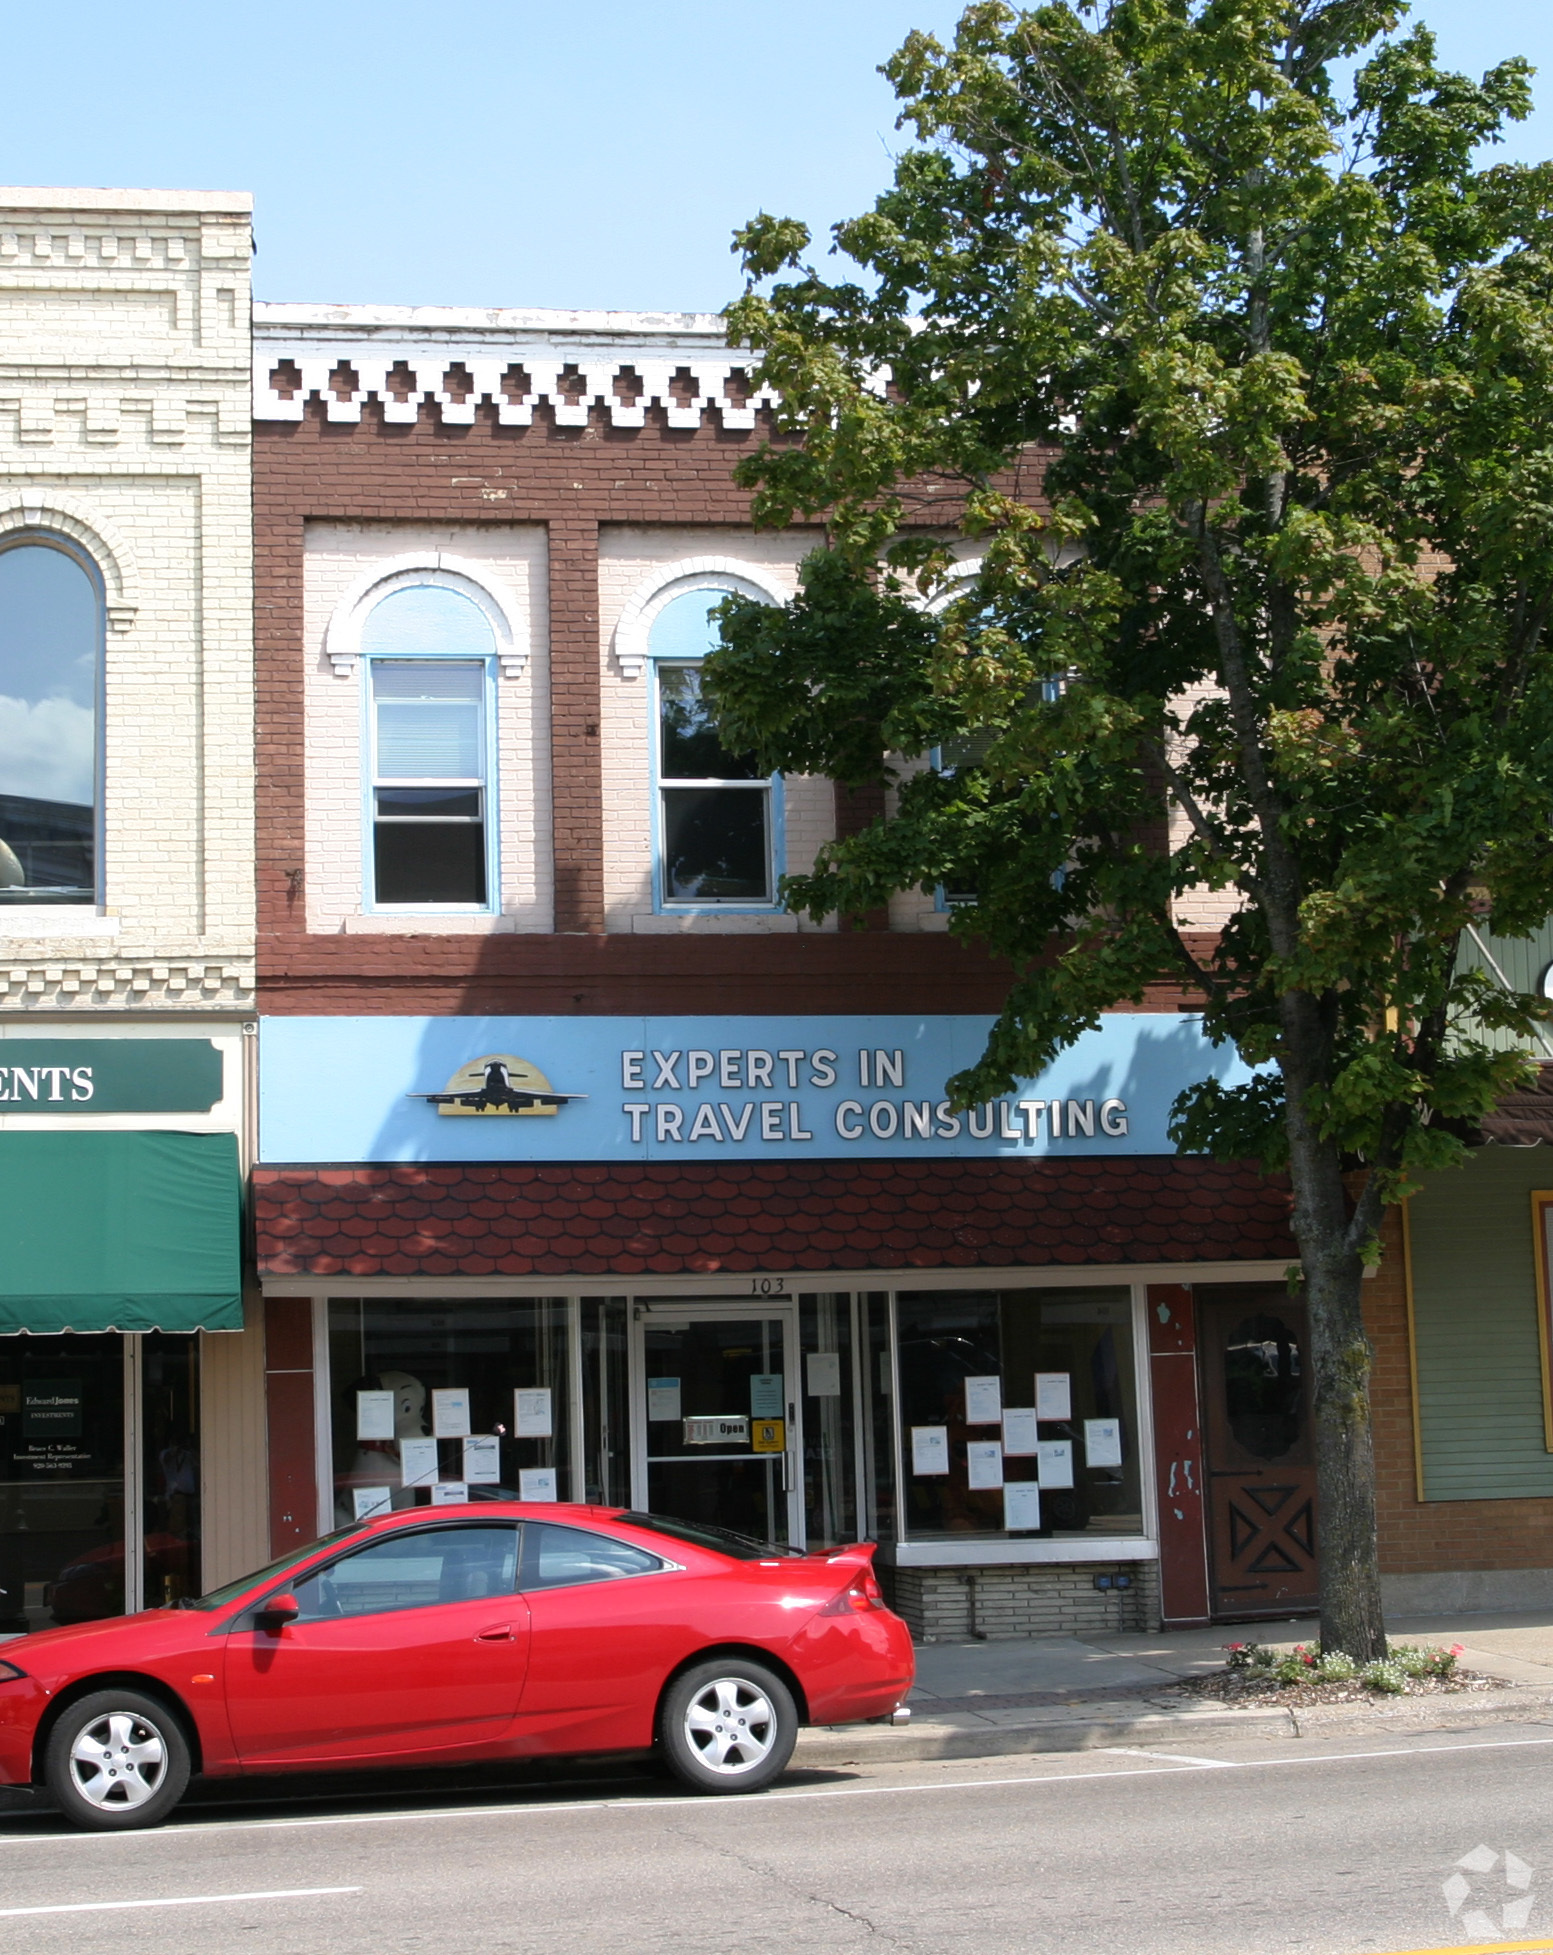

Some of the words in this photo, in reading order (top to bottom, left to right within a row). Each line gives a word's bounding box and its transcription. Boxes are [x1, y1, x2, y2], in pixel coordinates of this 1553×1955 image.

[621, 1048, 838, 1088] EXPERTS
[858, 1048, 904, 1088] IN
[622, 1101, 813, 1142] TRAVEL
[835, 1099, 1129, 1140] CONSULTING
[752, 1277, 784, 1295] 103
[720, 1422, 745, 1435] Open
